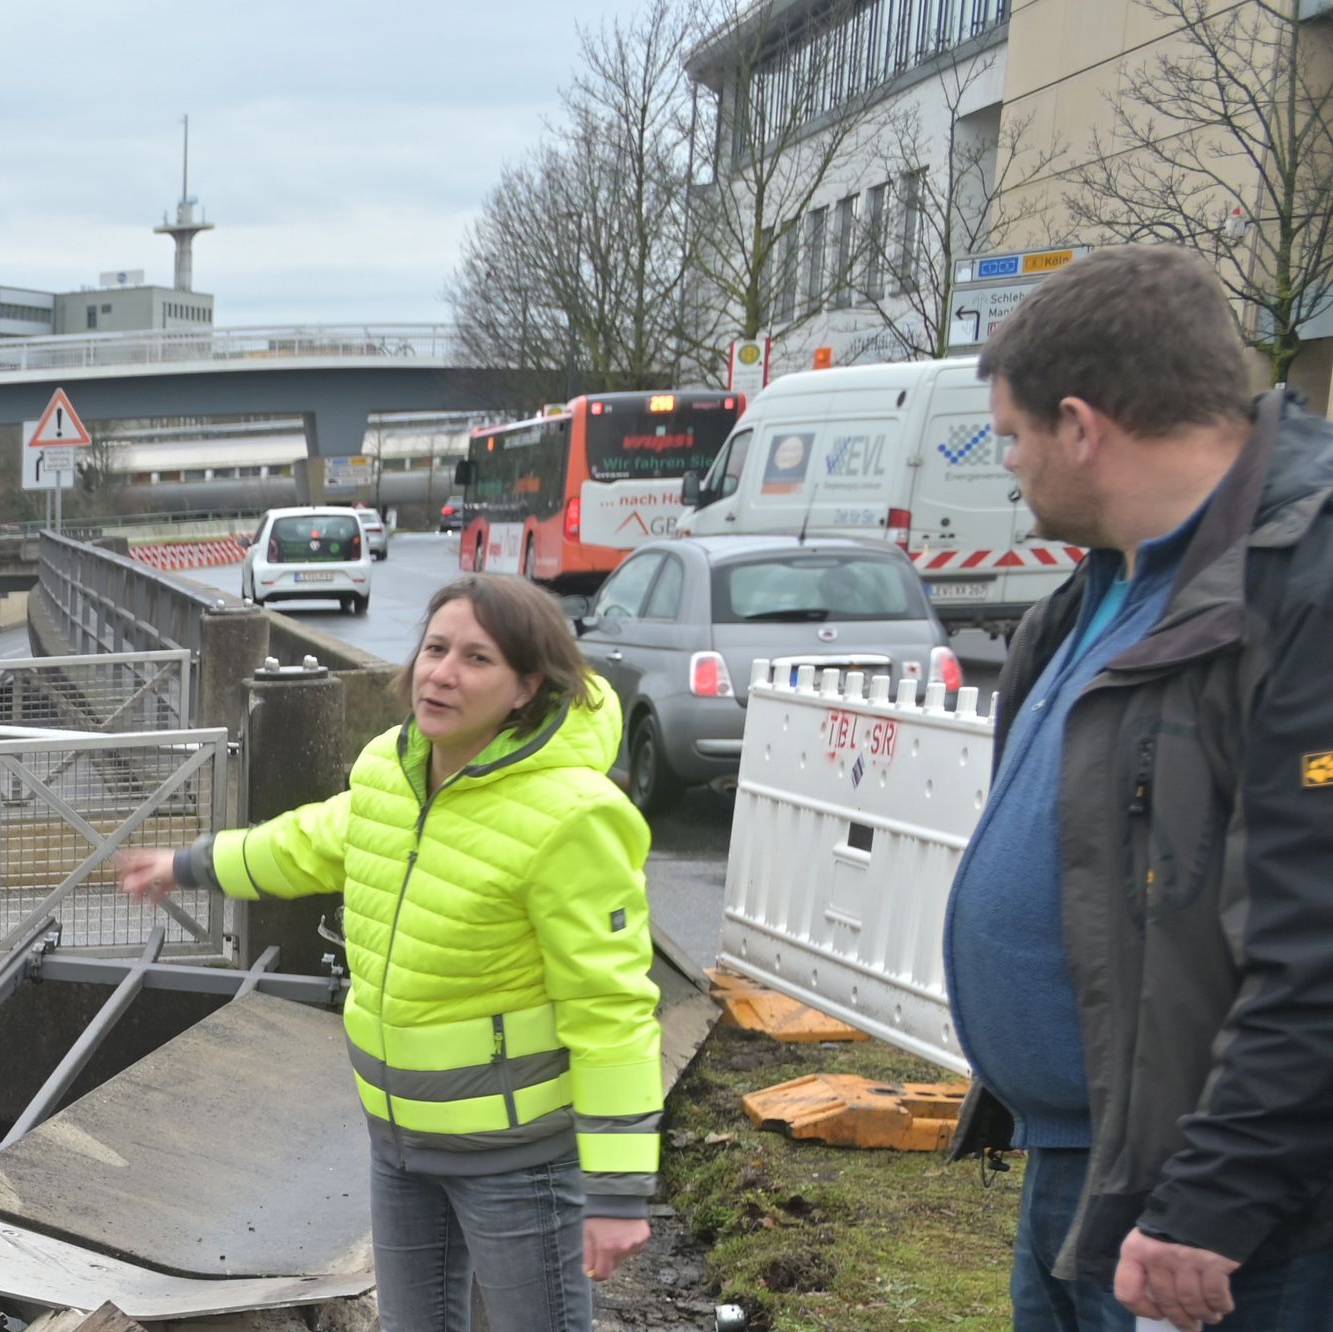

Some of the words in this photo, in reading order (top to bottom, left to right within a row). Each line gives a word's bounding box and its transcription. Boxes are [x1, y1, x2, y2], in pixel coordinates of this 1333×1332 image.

[1044, 255, 1070, 267] Köln
[990, 291, 1028, 304] Schleb
[844, 434, 886, 476] EVL
[634, 455, 685, 469] fahren
[619, 494, 657, 506] nach
[871, 718, 896, 756] SR
